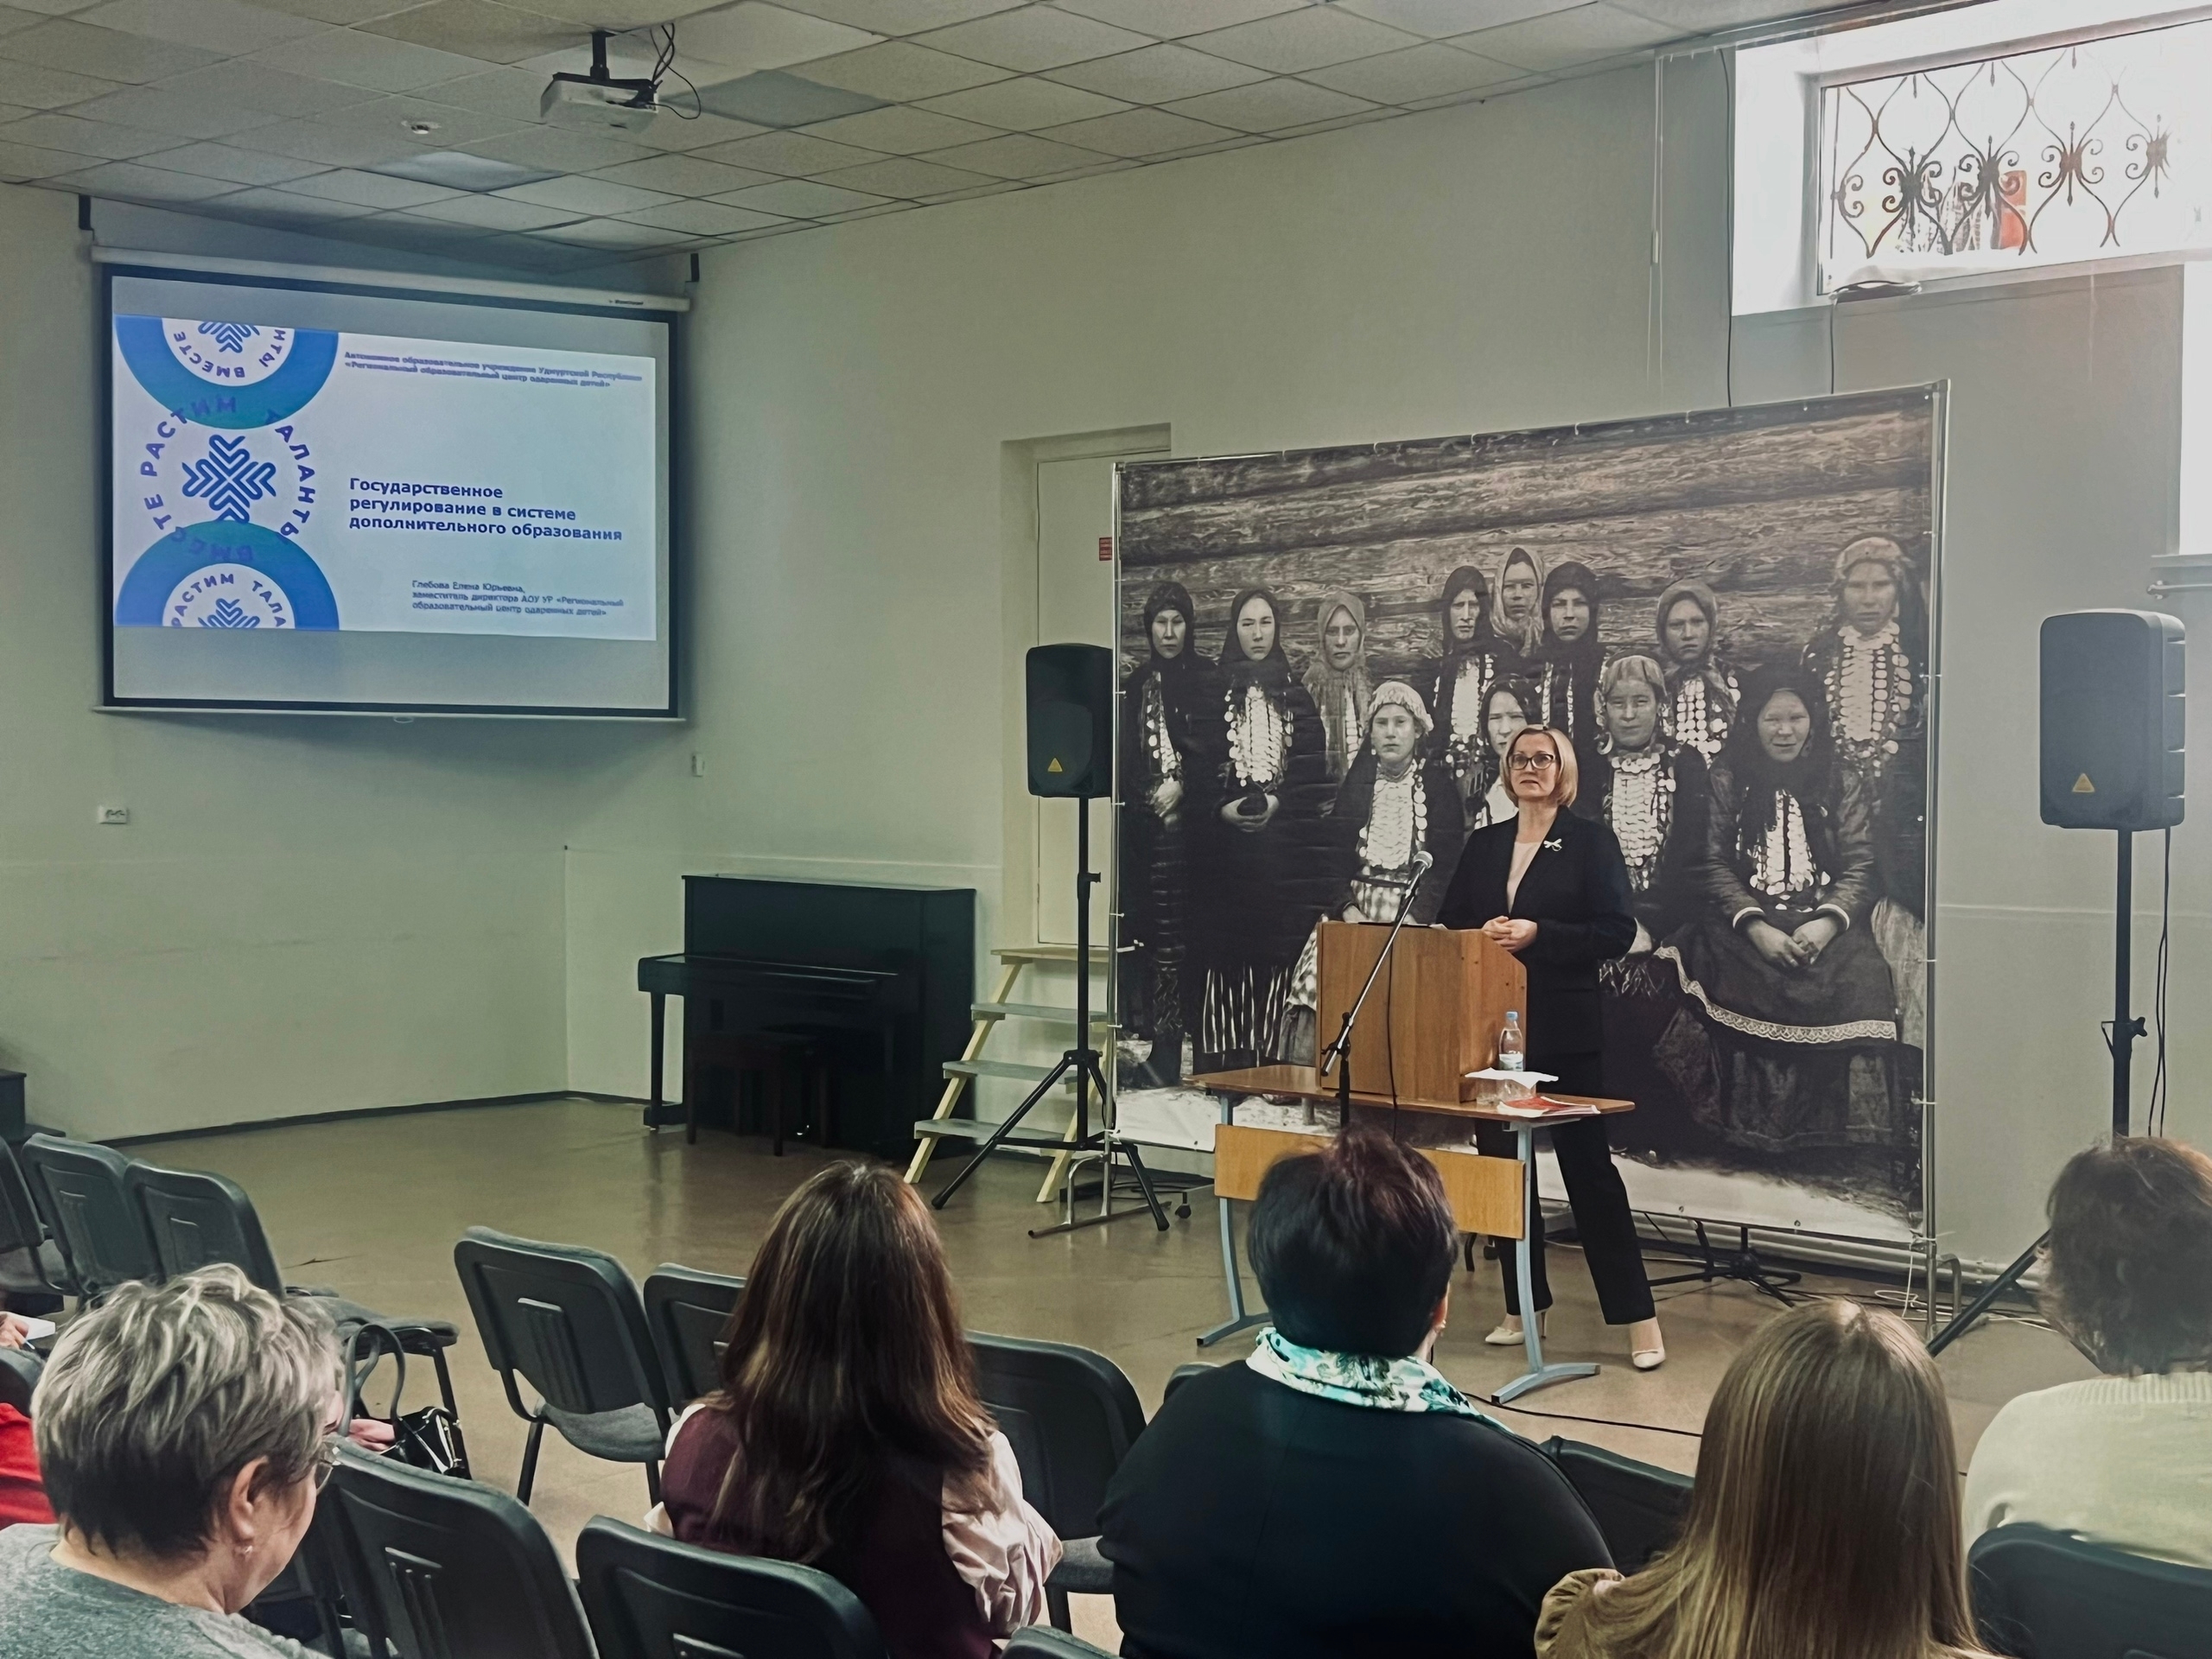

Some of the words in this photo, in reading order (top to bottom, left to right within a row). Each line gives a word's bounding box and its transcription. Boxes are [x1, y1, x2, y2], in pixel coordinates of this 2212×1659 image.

[174, 331, 245, 378] ВМЕСТЕ
[140, 397, 236, 477] РАСТИМ
[350, 478, 503, 499] Государственное
[350, 499, 486, 515] регулирование
[493, 506, 502, 516] в
[507, 507, 576, 520] системе
[349, 518, 506, 534] дополнительного
[512, 524, 622, 540] образования
[412, 580, 449, 589] Глебова
[453, 582, 480, 590] Елена
[171, 574, 234, 628] РАСТИМ
[252, 581, 286, 626] ТАЛА
[542, 595, 554, 604] УР
